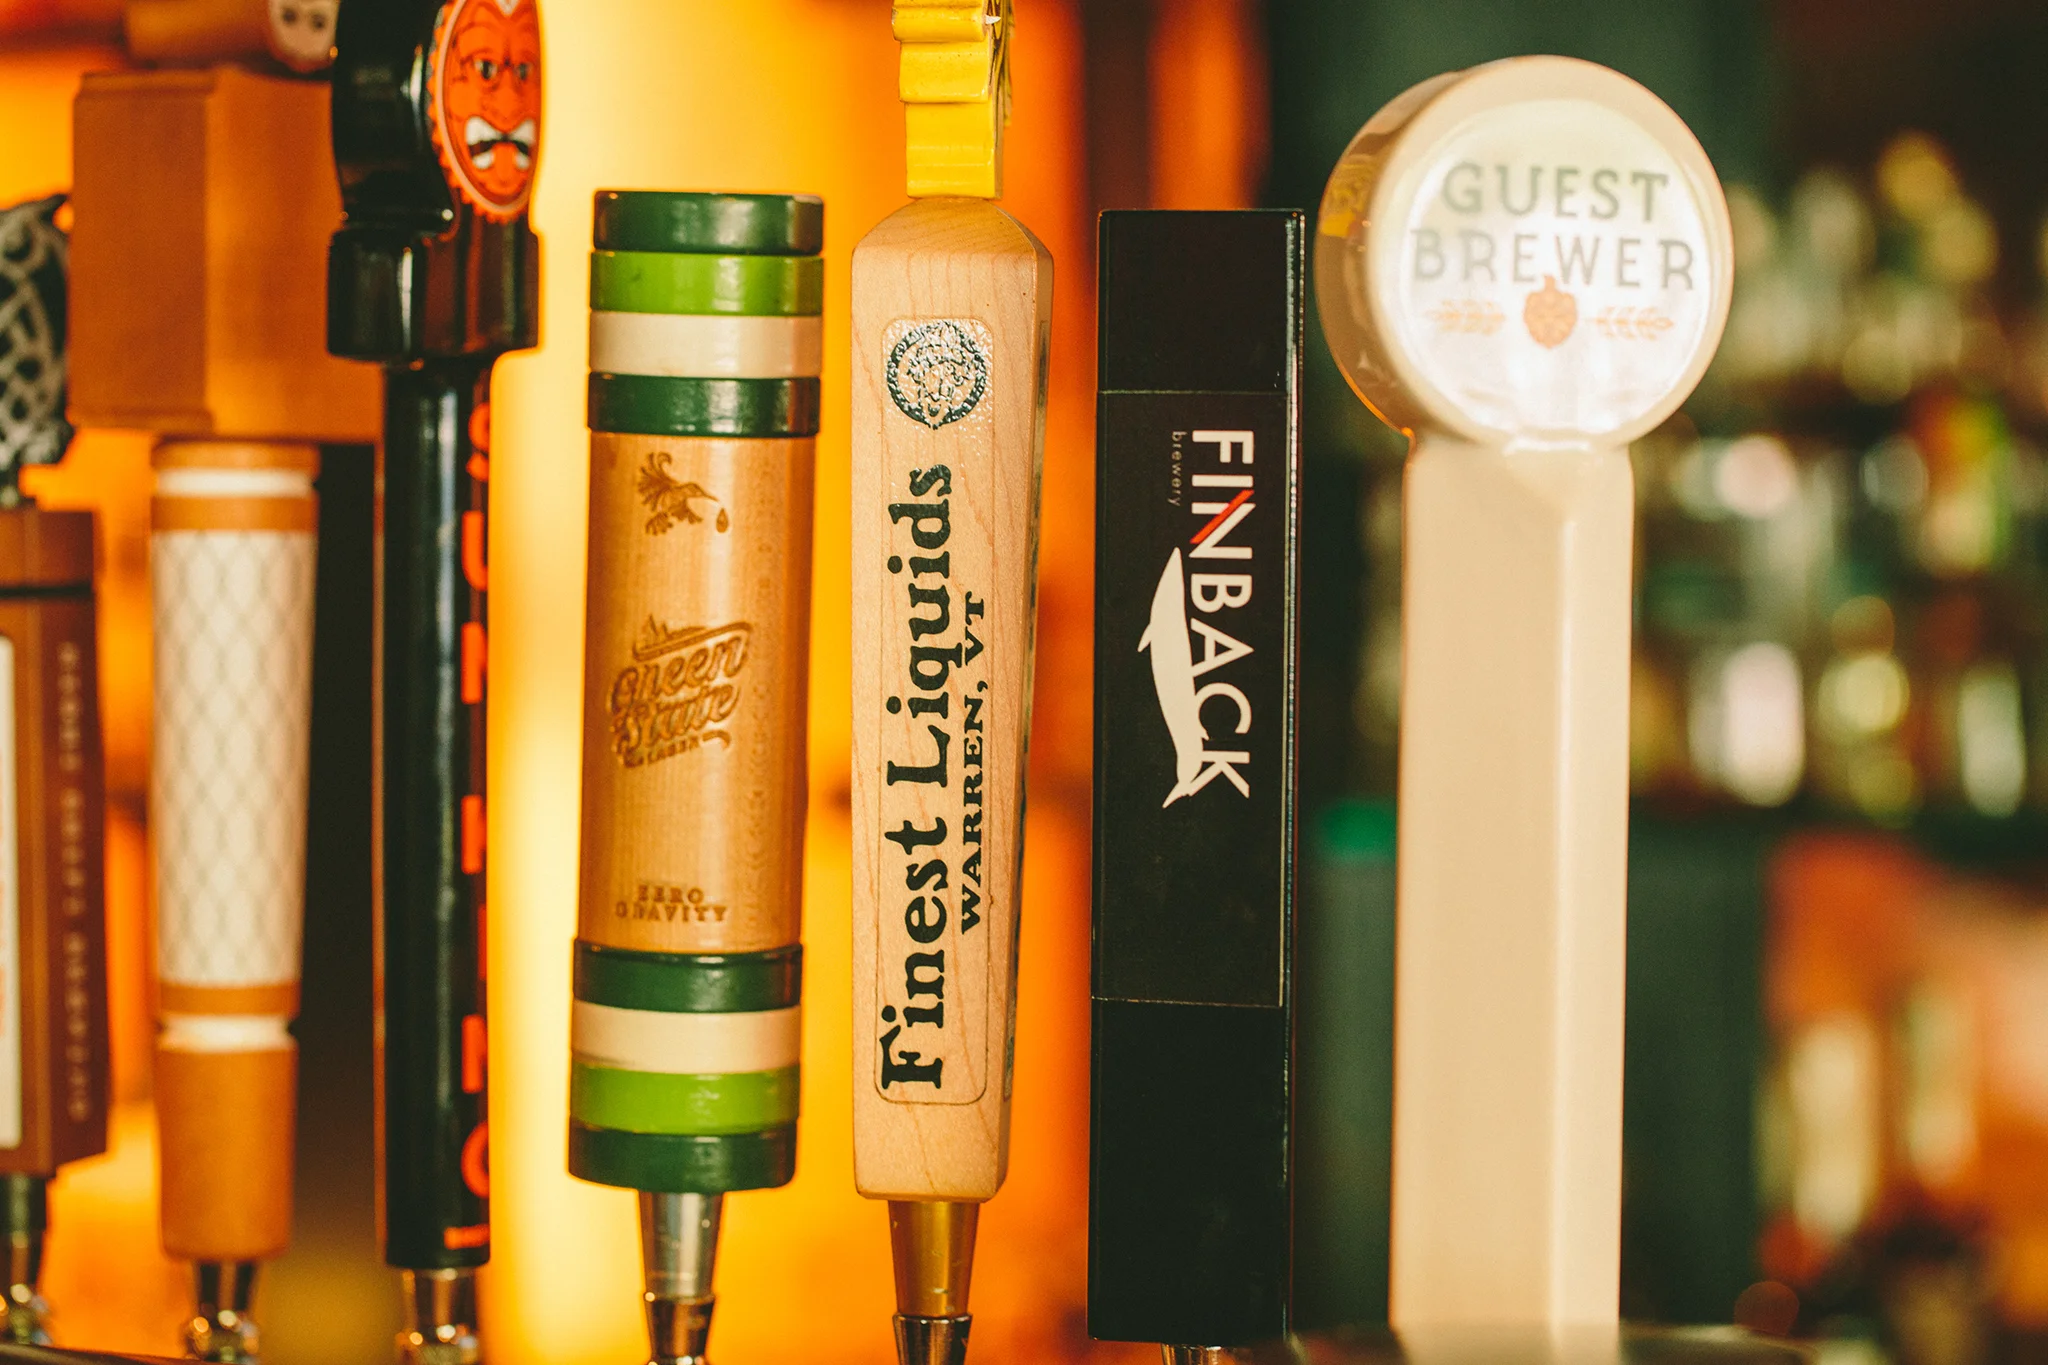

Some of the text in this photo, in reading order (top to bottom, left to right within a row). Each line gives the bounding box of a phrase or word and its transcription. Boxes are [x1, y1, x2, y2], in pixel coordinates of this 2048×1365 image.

[1441, 161, 1670, 224] GUEST
[1409, 227, 1695, 291] BREWER
[1167, 430, 1188, 507] brewery
[886, 463, 963, 788] Liquids
[1187, 429, 1257, 800] FINBACK
[610, 634, 747, 716] Green
[961, 590, 989, 935] WARREN, VT
[638, 884, 704, 904] ZERO
[879, 816, 949, 1090] Finest
